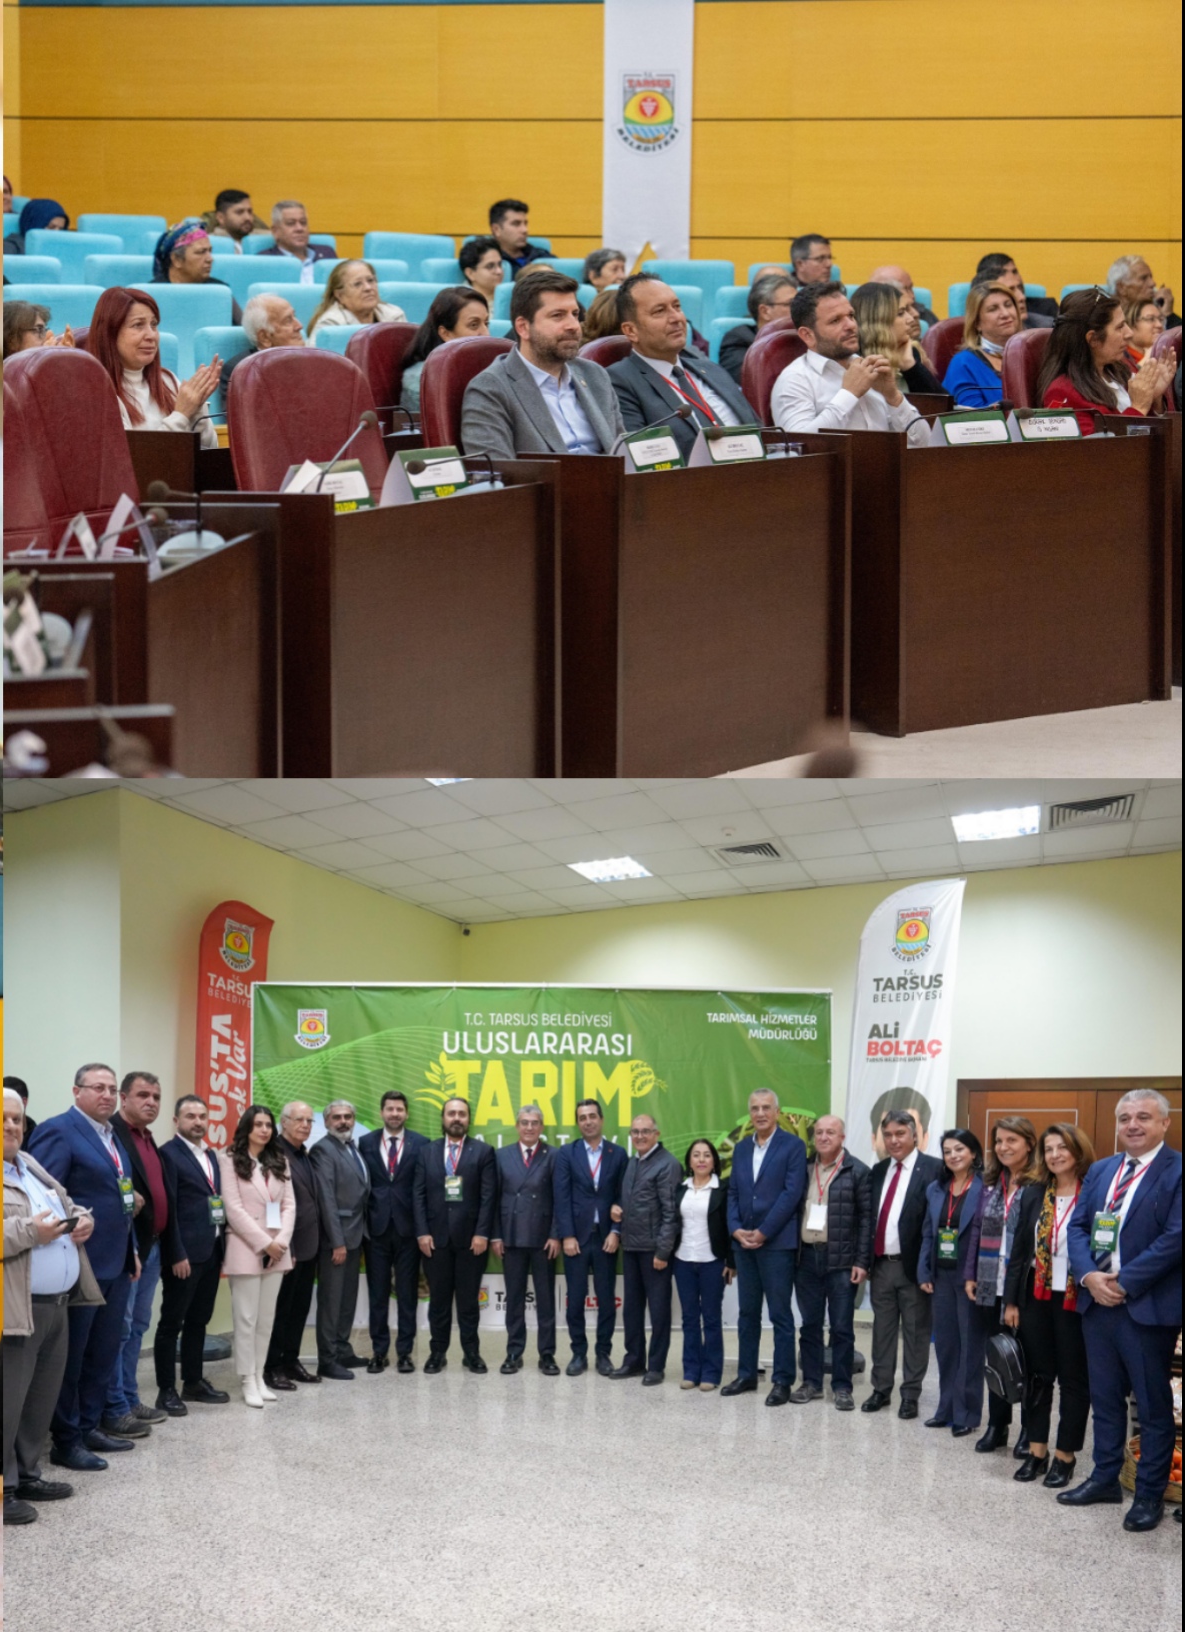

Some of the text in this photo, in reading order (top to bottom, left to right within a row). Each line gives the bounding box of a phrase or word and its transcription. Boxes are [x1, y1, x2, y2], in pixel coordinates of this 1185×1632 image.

[207, 972, 251, 998] TARSU
[873, 974, 943, 992] TARSUS
[464, 1011, 612, 1028] T.C. TARSUS BELEDİYESİ
[706, 1011, 817, 1025] TARIMSAL HİZMETLER
[748, 1027, 817, 1041] MÜDÜRLÜĞÜ
[443, 1031, 632, 1056] ULUSLARARASI
[867, 1039, 943, 1058] BOLTAÇ
[443, 1059, 633, 1127] TARIM
